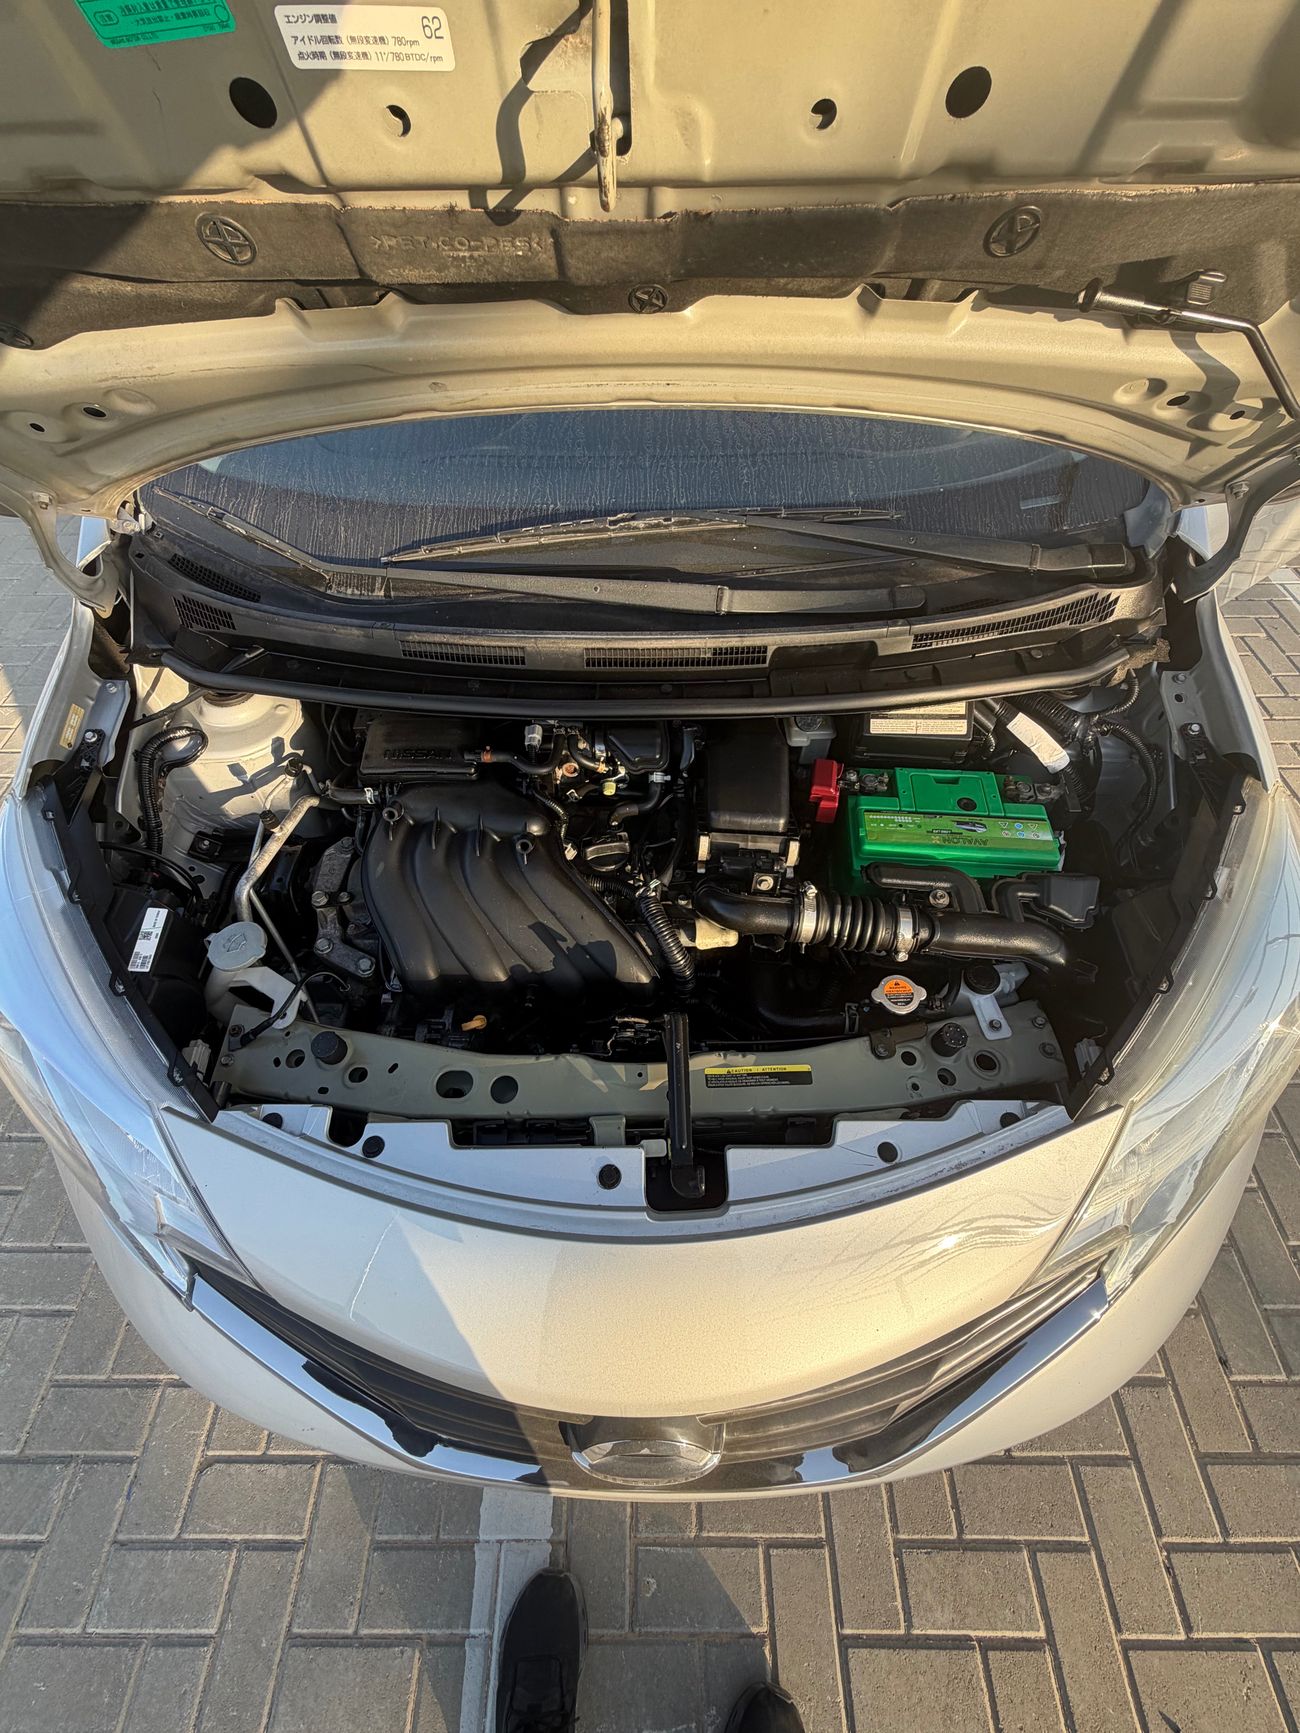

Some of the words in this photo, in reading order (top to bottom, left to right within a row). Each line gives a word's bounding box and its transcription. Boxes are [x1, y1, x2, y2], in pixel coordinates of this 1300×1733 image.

[284, 13, 338, 24] エンジン調整値
[421, 15, 444, 39] 62
[391, 36, 420, 48] 780rpm
